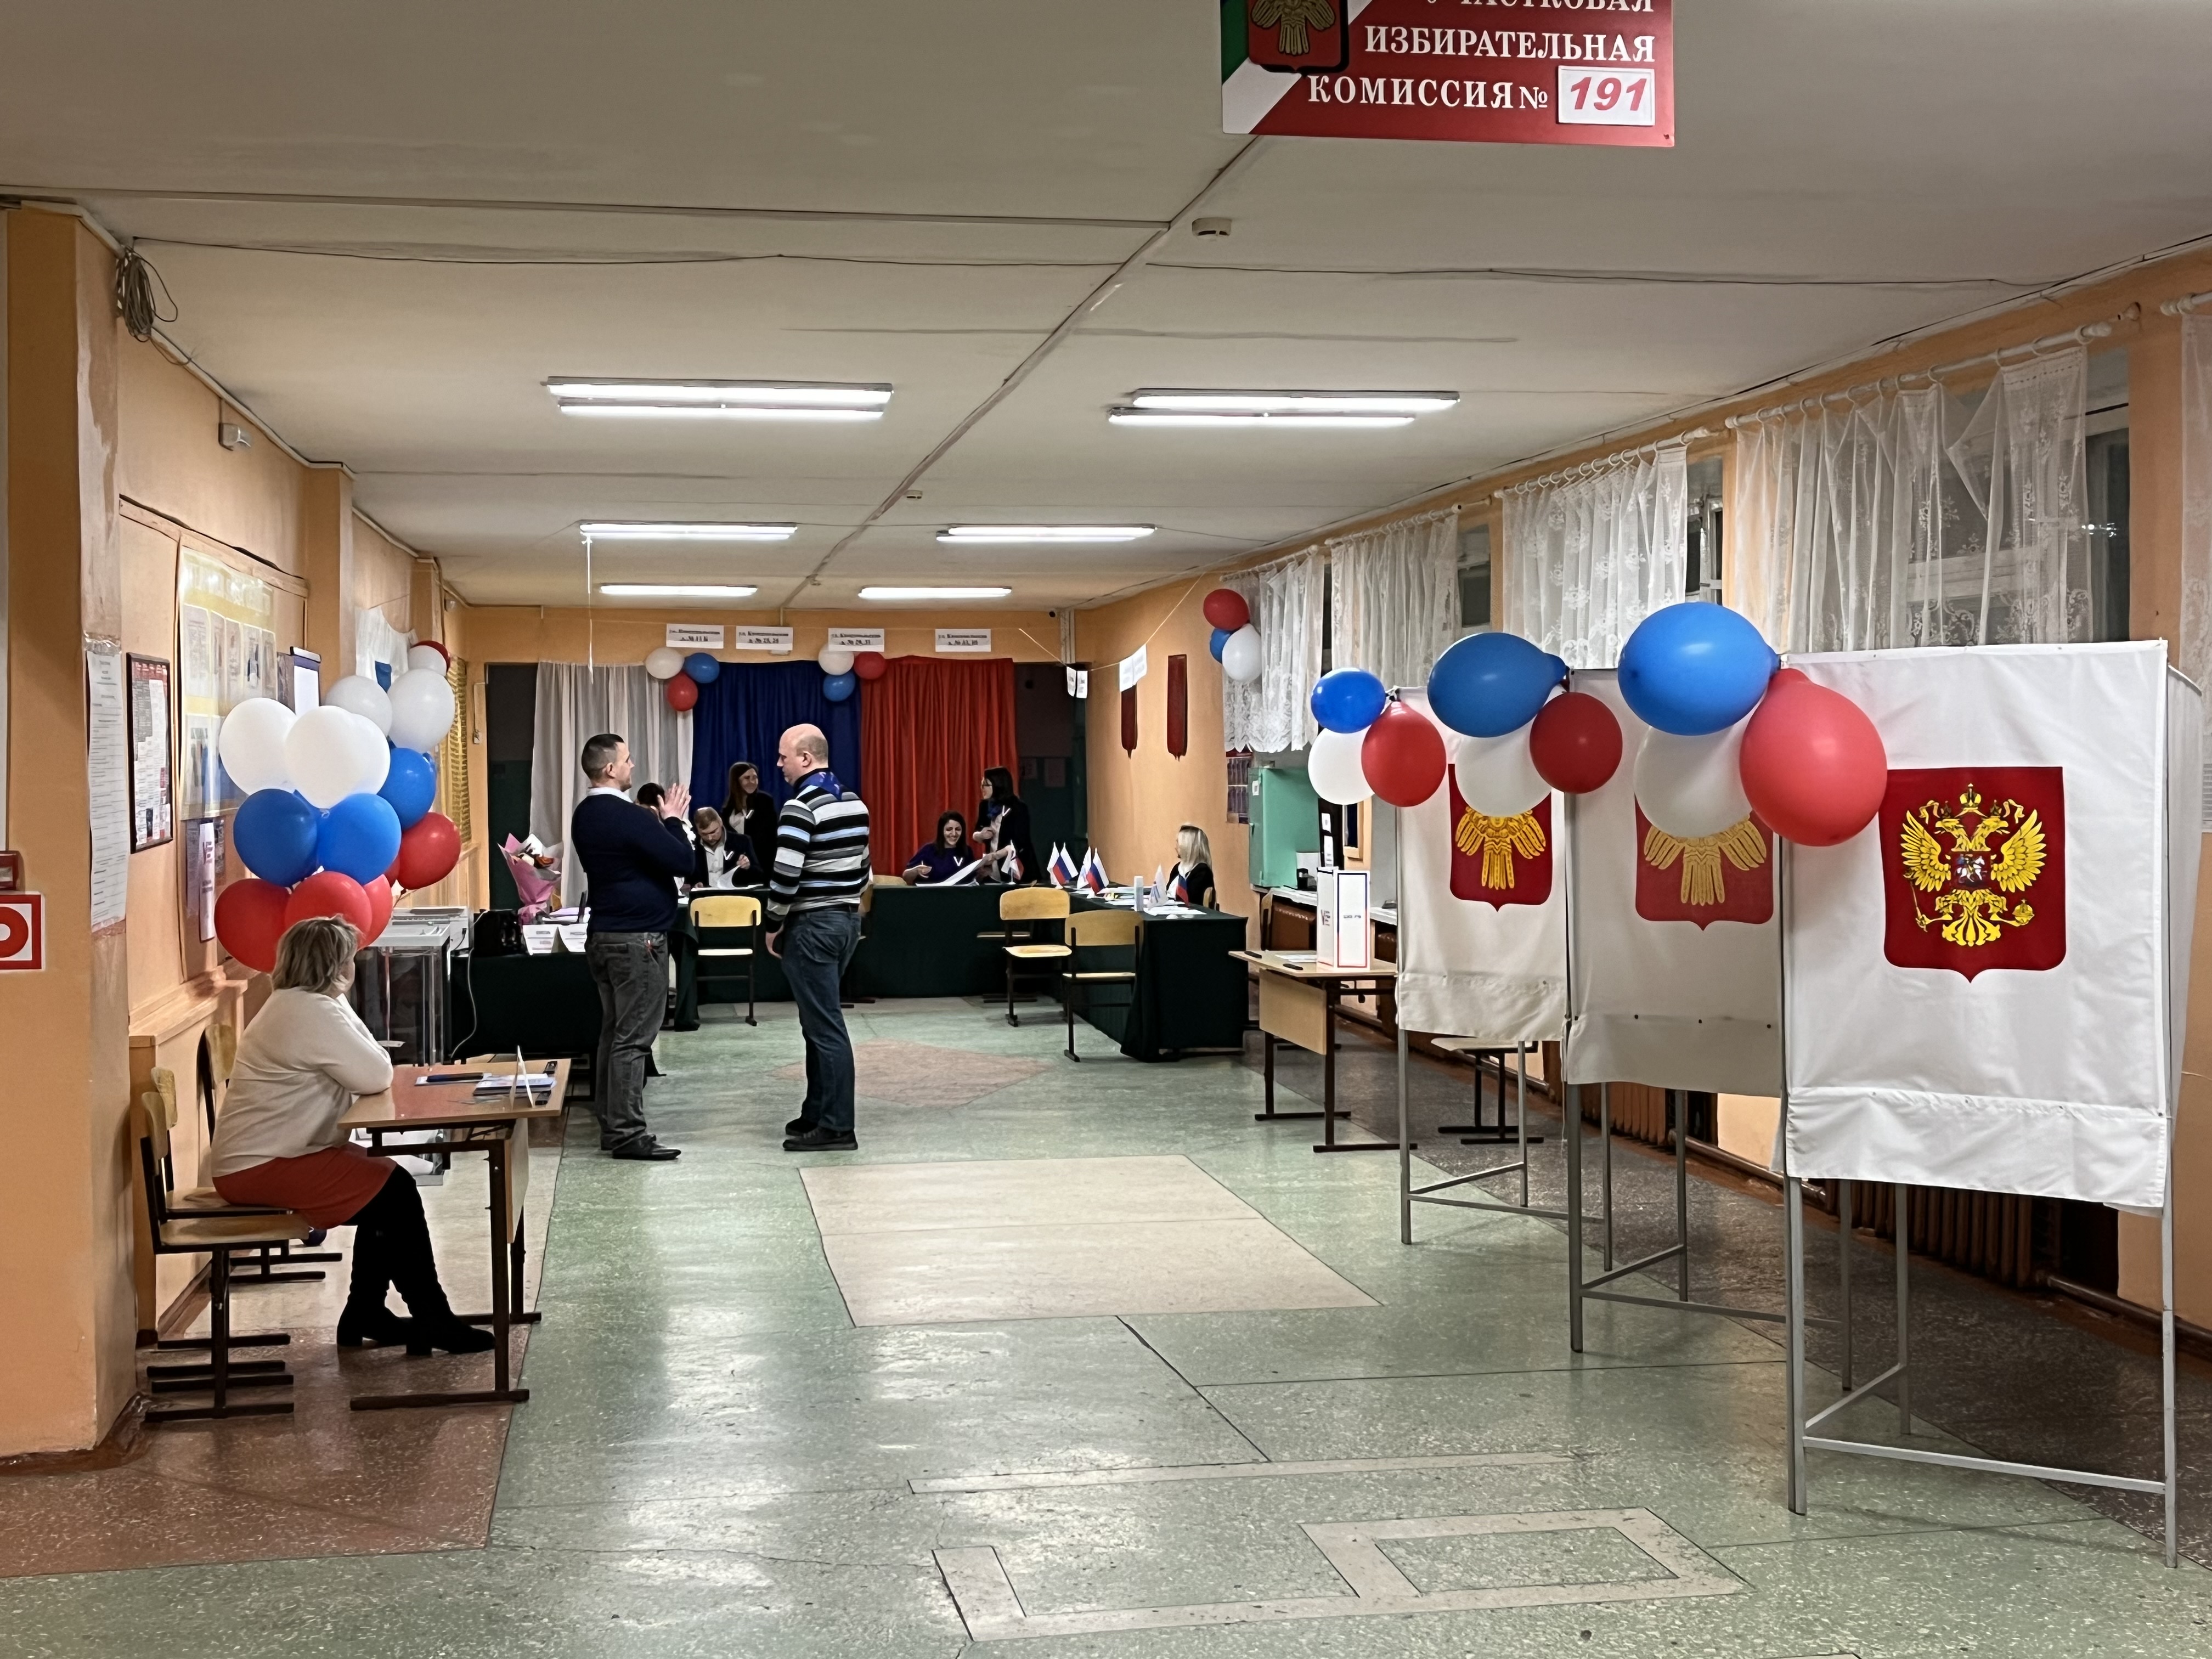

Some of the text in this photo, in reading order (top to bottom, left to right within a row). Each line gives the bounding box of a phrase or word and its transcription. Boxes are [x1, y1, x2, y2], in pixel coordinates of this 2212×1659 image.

[1365, 26, 1655, 62] ИЗБИРАТЕЛЬНАЯ
[1308, 76, 1514, 109] КОМИССИЯ
[1570, 77, 1646, 111] 191
